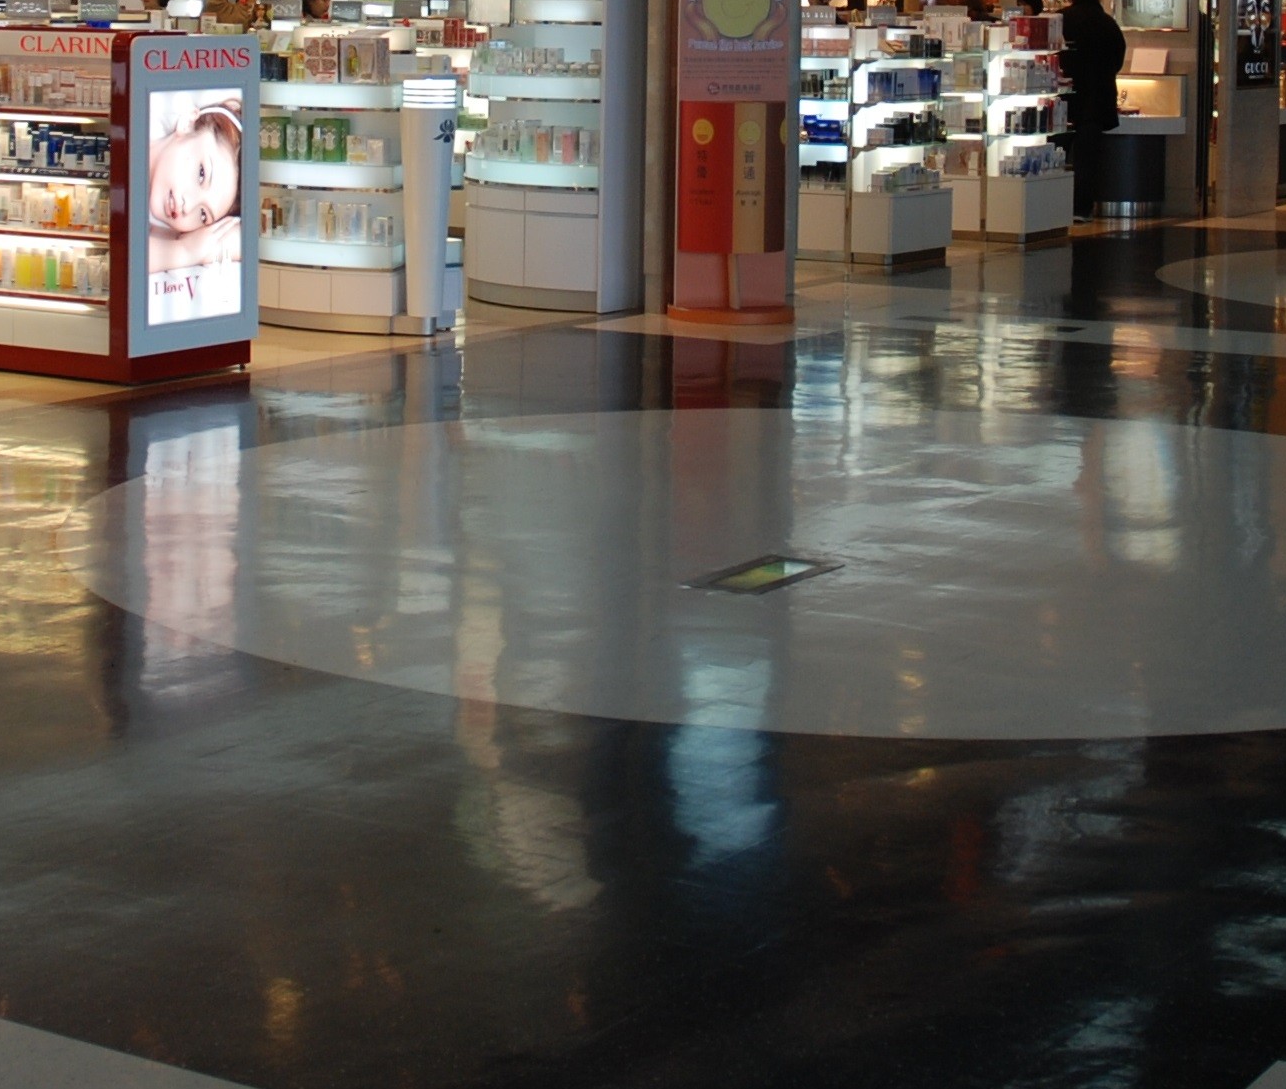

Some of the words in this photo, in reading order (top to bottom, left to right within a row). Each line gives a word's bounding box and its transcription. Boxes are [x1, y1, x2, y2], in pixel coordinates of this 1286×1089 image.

[20, 34, 110, 55] CLARIN
[143, 47, 251, 72] CLARINS
[1244, 61, 1269, 74] GUCCI
[163, 280, 184, 295] love
[185, 274, 200, 301] V
